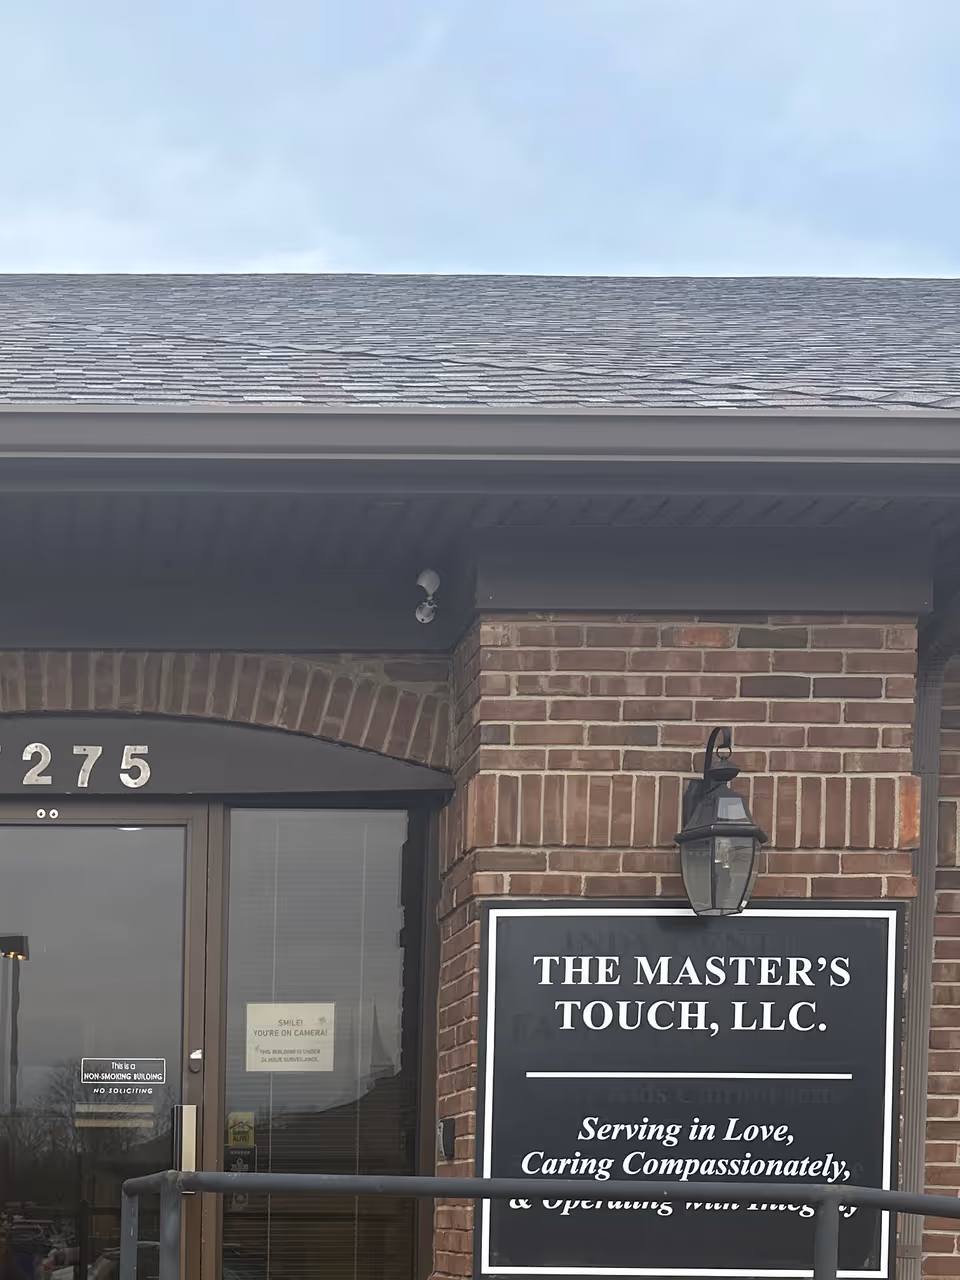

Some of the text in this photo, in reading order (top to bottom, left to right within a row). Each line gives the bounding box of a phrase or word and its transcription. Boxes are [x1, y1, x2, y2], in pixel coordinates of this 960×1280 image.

[534, 956, 851, 986] THE MASTER'S
[555, 1000, 720, 1037] TOUCH,
[731, 1001, 827, 1031] LLC.
[578, 1117, 794, 1146] Serving in Love,
[521, 1152, 851, 1181] Caring Compassionately,
